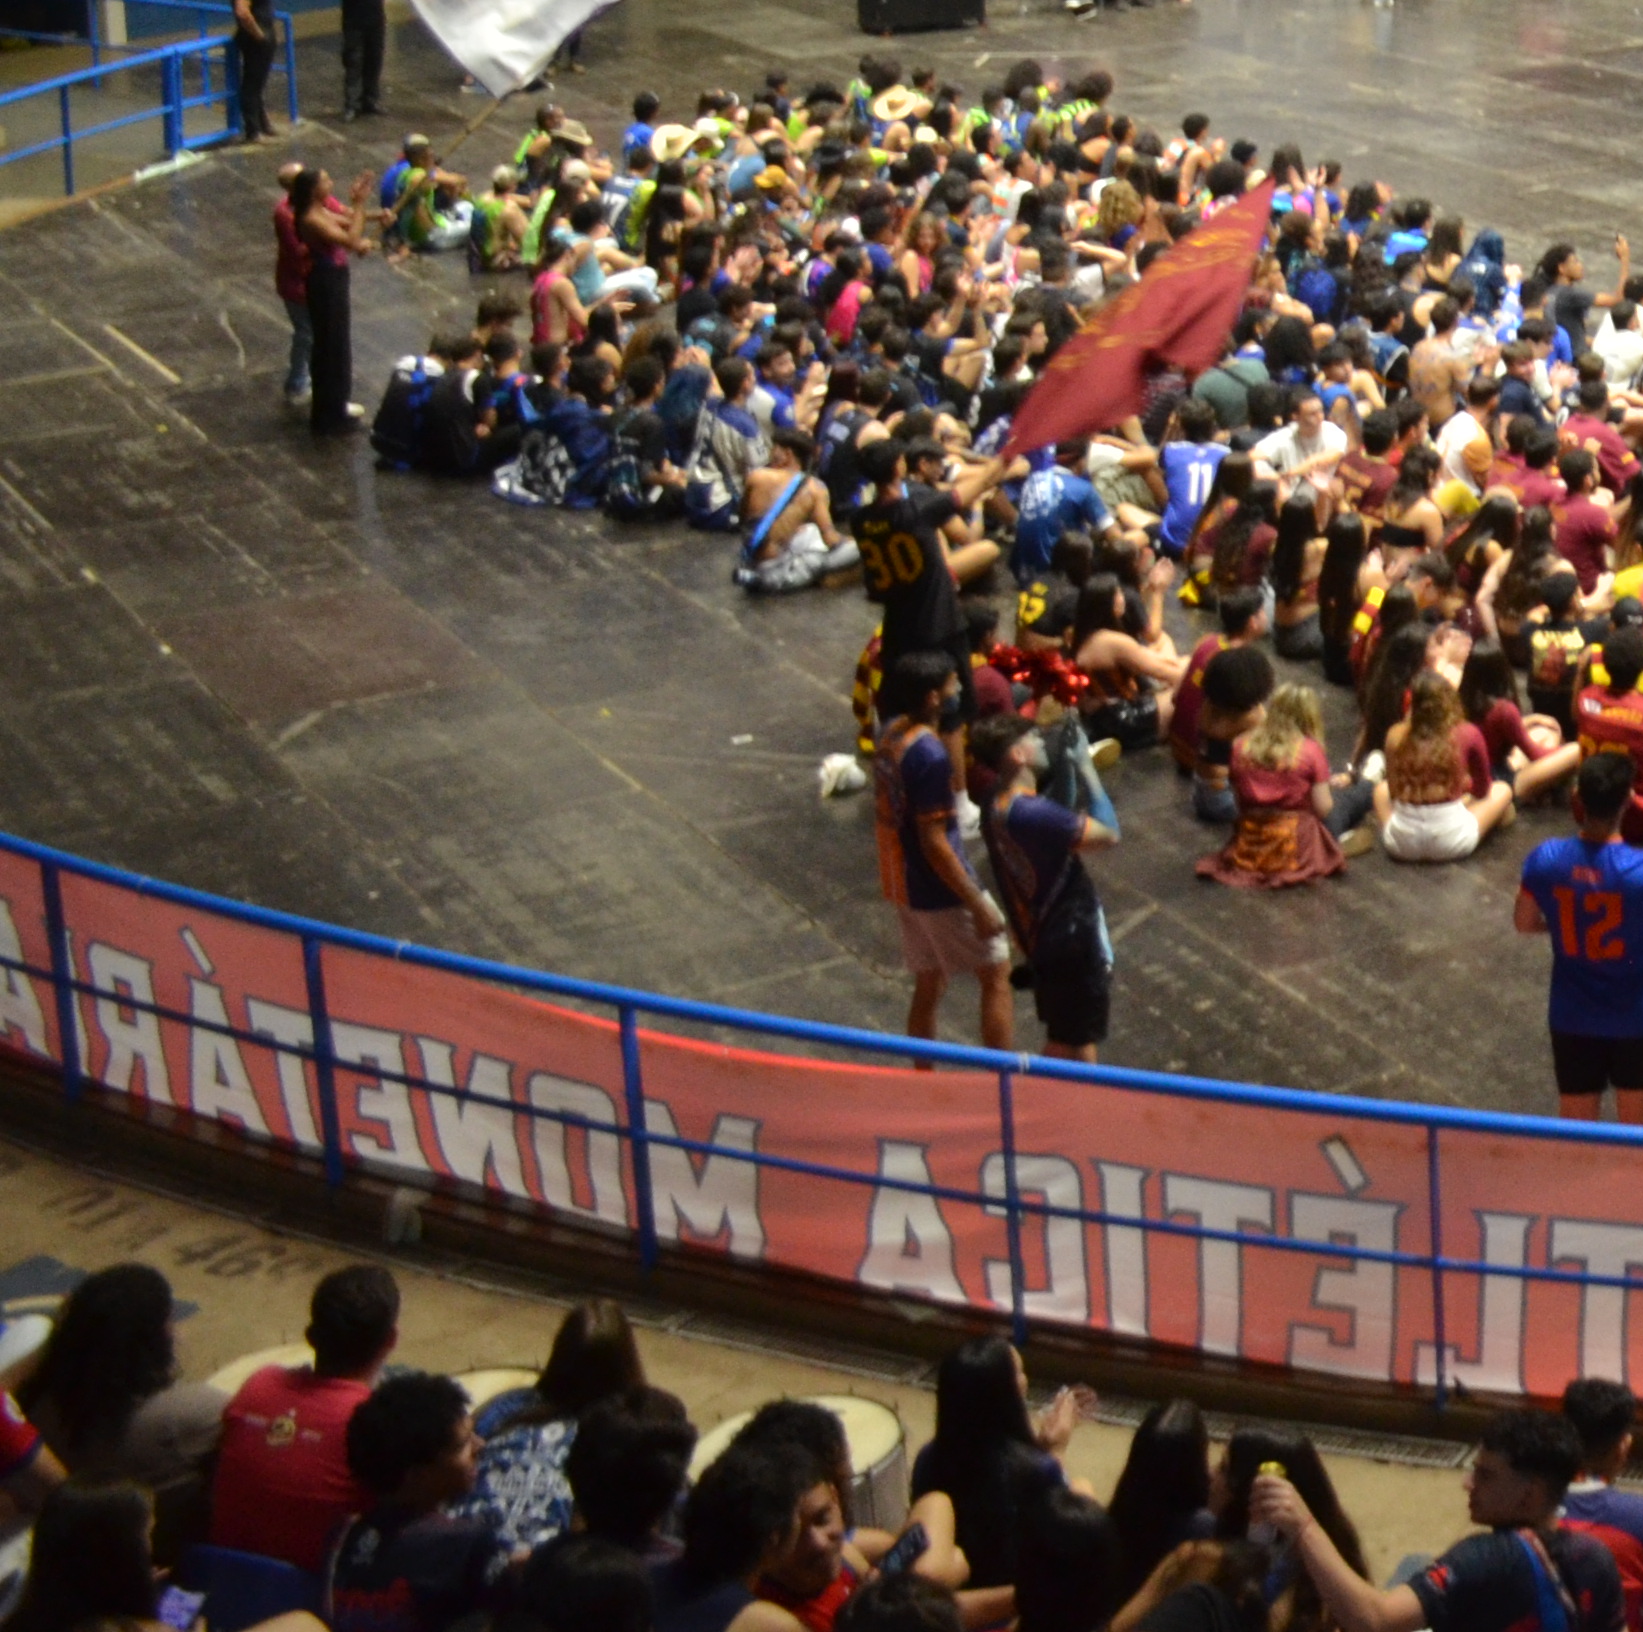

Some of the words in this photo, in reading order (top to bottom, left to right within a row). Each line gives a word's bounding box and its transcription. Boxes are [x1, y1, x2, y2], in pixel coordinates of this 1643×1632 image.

[1186, 462, 1214, 506] 11
[858, 531, 925, 591] 30
[1552, 885, 1626, 962] 12
